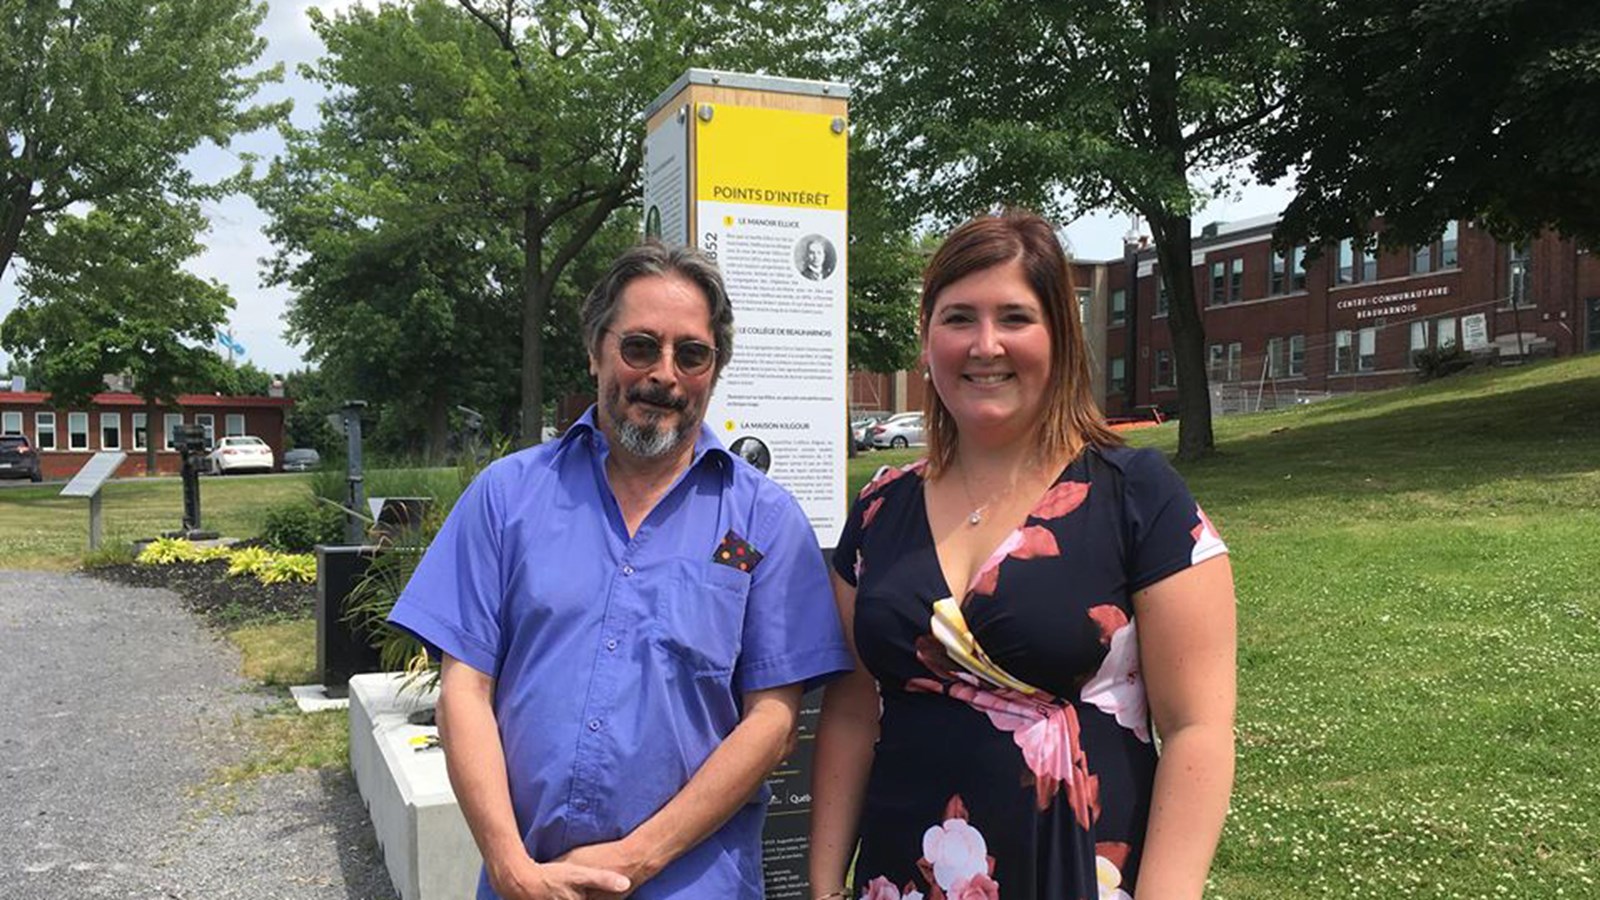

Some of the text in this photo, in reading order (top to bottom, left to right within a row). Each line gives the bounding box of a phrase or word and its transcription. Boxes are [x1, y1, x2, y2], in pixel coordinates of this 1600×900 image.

[713, 186, 763, 201] POINTS
[738, 217, 746, 225] LE
[747, 218, 777, 227] MANOIR
[1356, 303, 1418, 319] BEAUHARNOIS
[776, 328, 785, 336] DE
[786, 327, 832, 337] BEAUHARNOIS
[741, 422, 752, 430] LA
[753, 422, 779, 430] MAISON
[780, 422, 810, 430] KILGOUR
